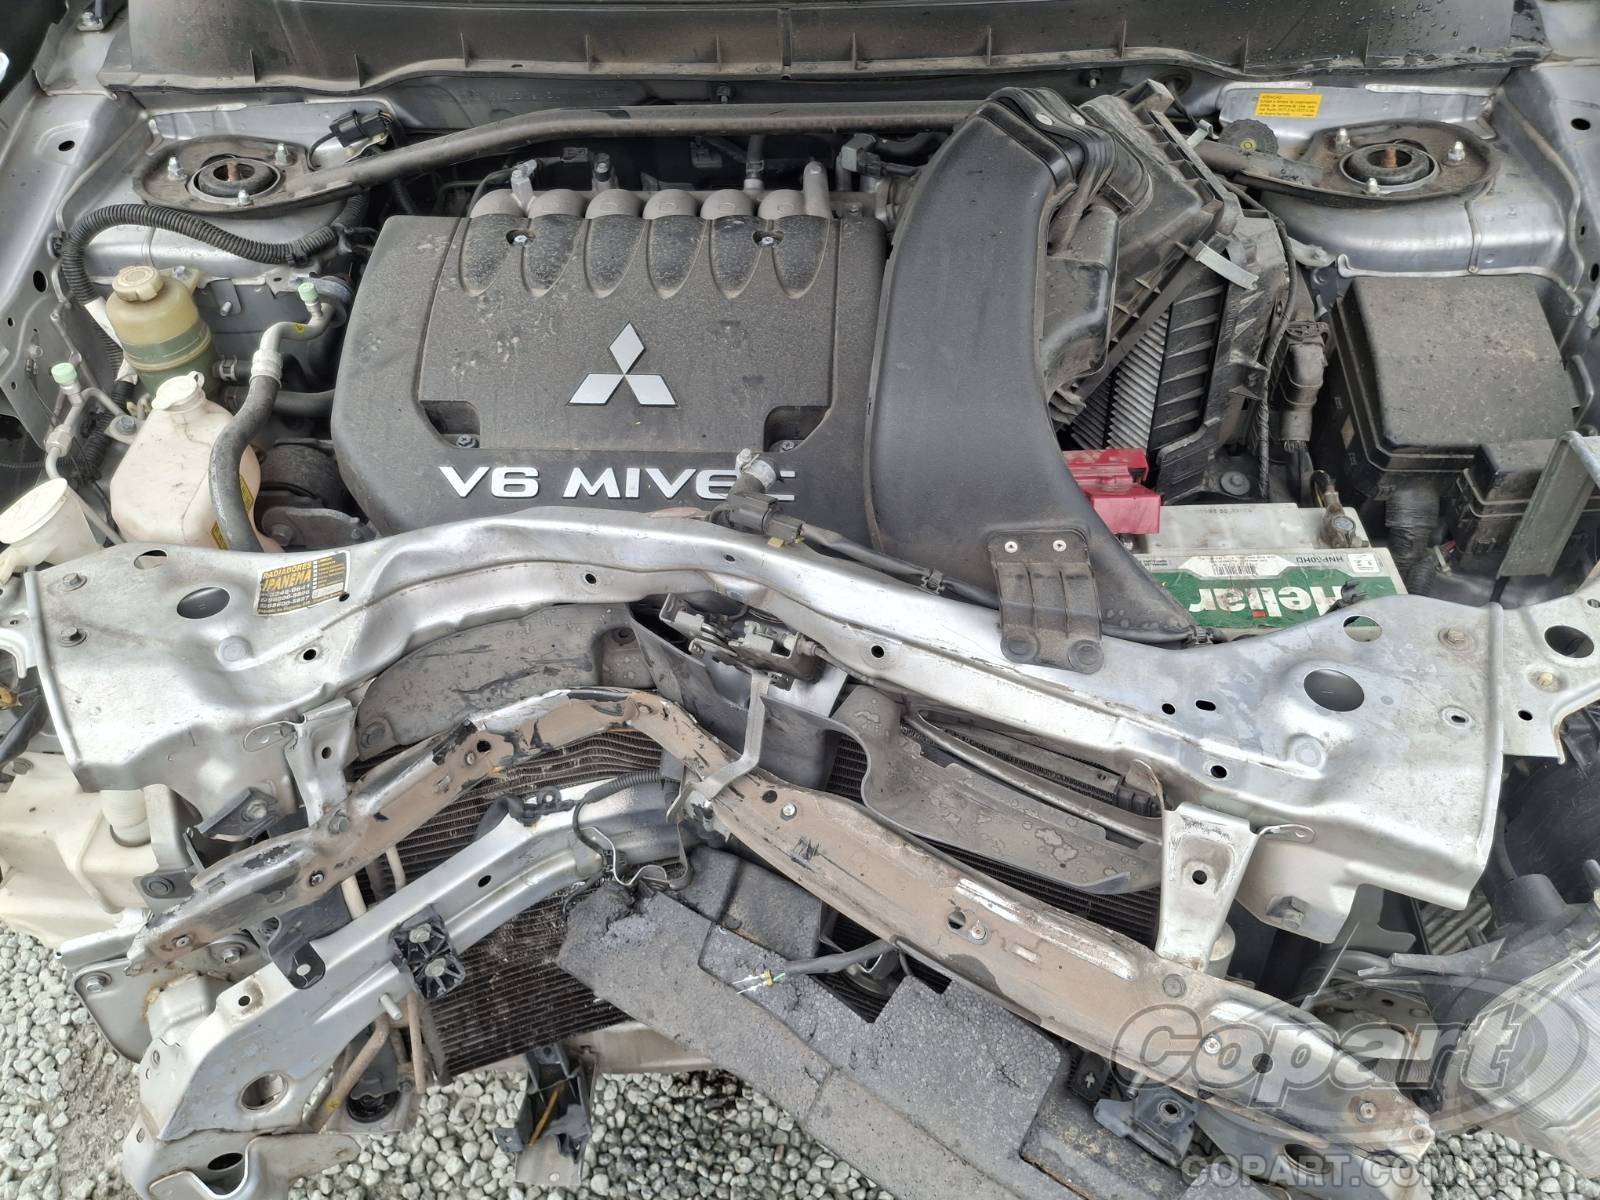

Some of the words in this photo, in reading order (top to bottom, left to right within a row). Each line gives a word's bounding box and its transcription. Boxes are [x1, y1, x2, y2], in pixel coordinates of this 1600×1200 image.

[439, 467, 540, 498] V6
[262, 568, 312, 592] IPANEMA
[263, 561, 312, 579] RADIADORES
[1188, 584, 1343, 618] Heliar
